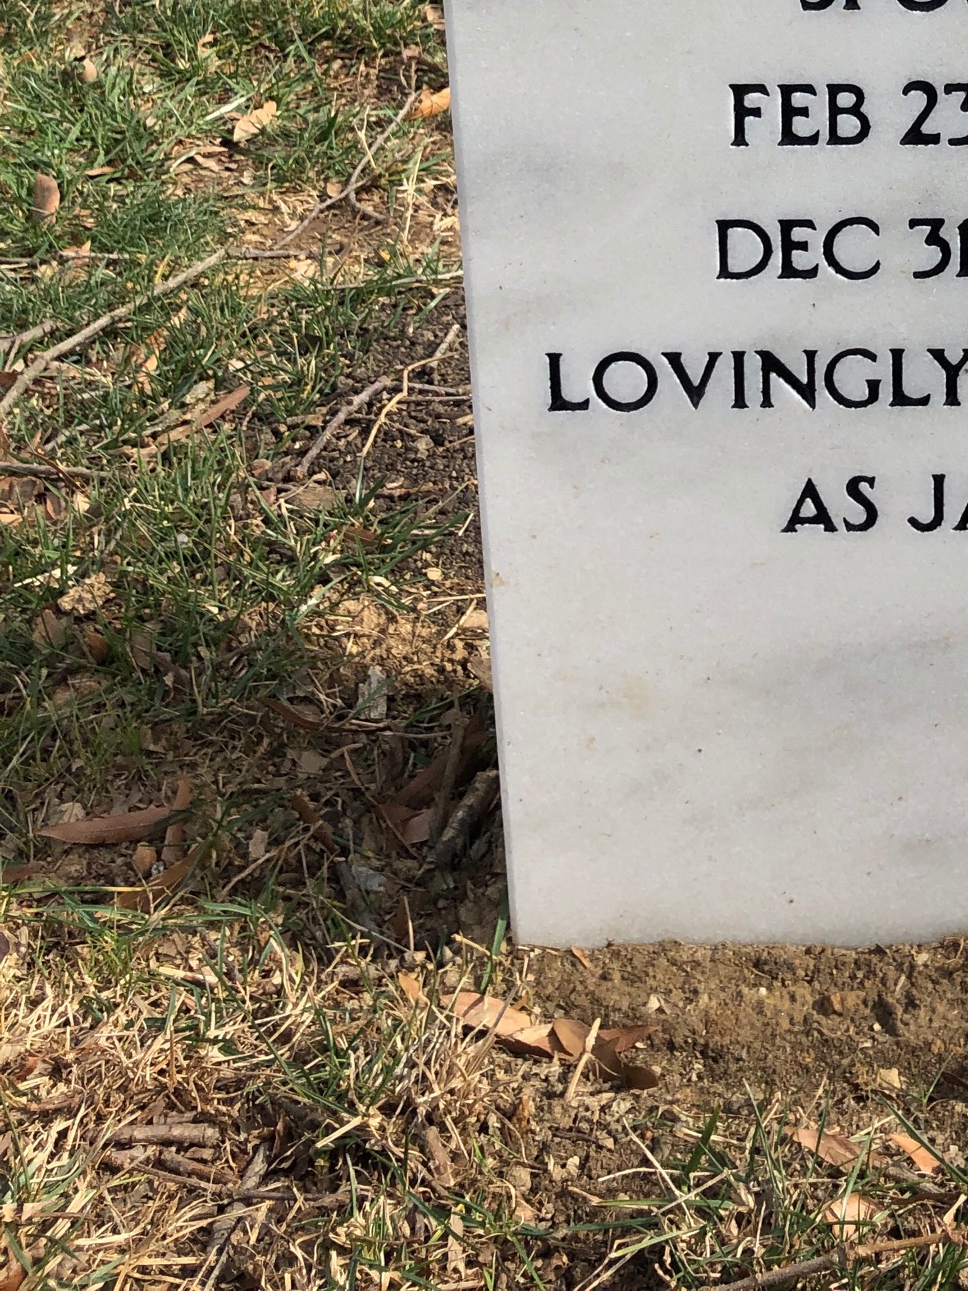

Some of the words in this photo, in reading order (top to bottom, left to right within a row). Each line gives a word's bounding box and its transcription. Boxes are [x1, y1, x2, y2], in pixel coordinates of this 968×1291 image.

[729, 83, 872, 147] FEB
[715, 216, 881, 280] DEC
[781, 476, 878, 534] AS
